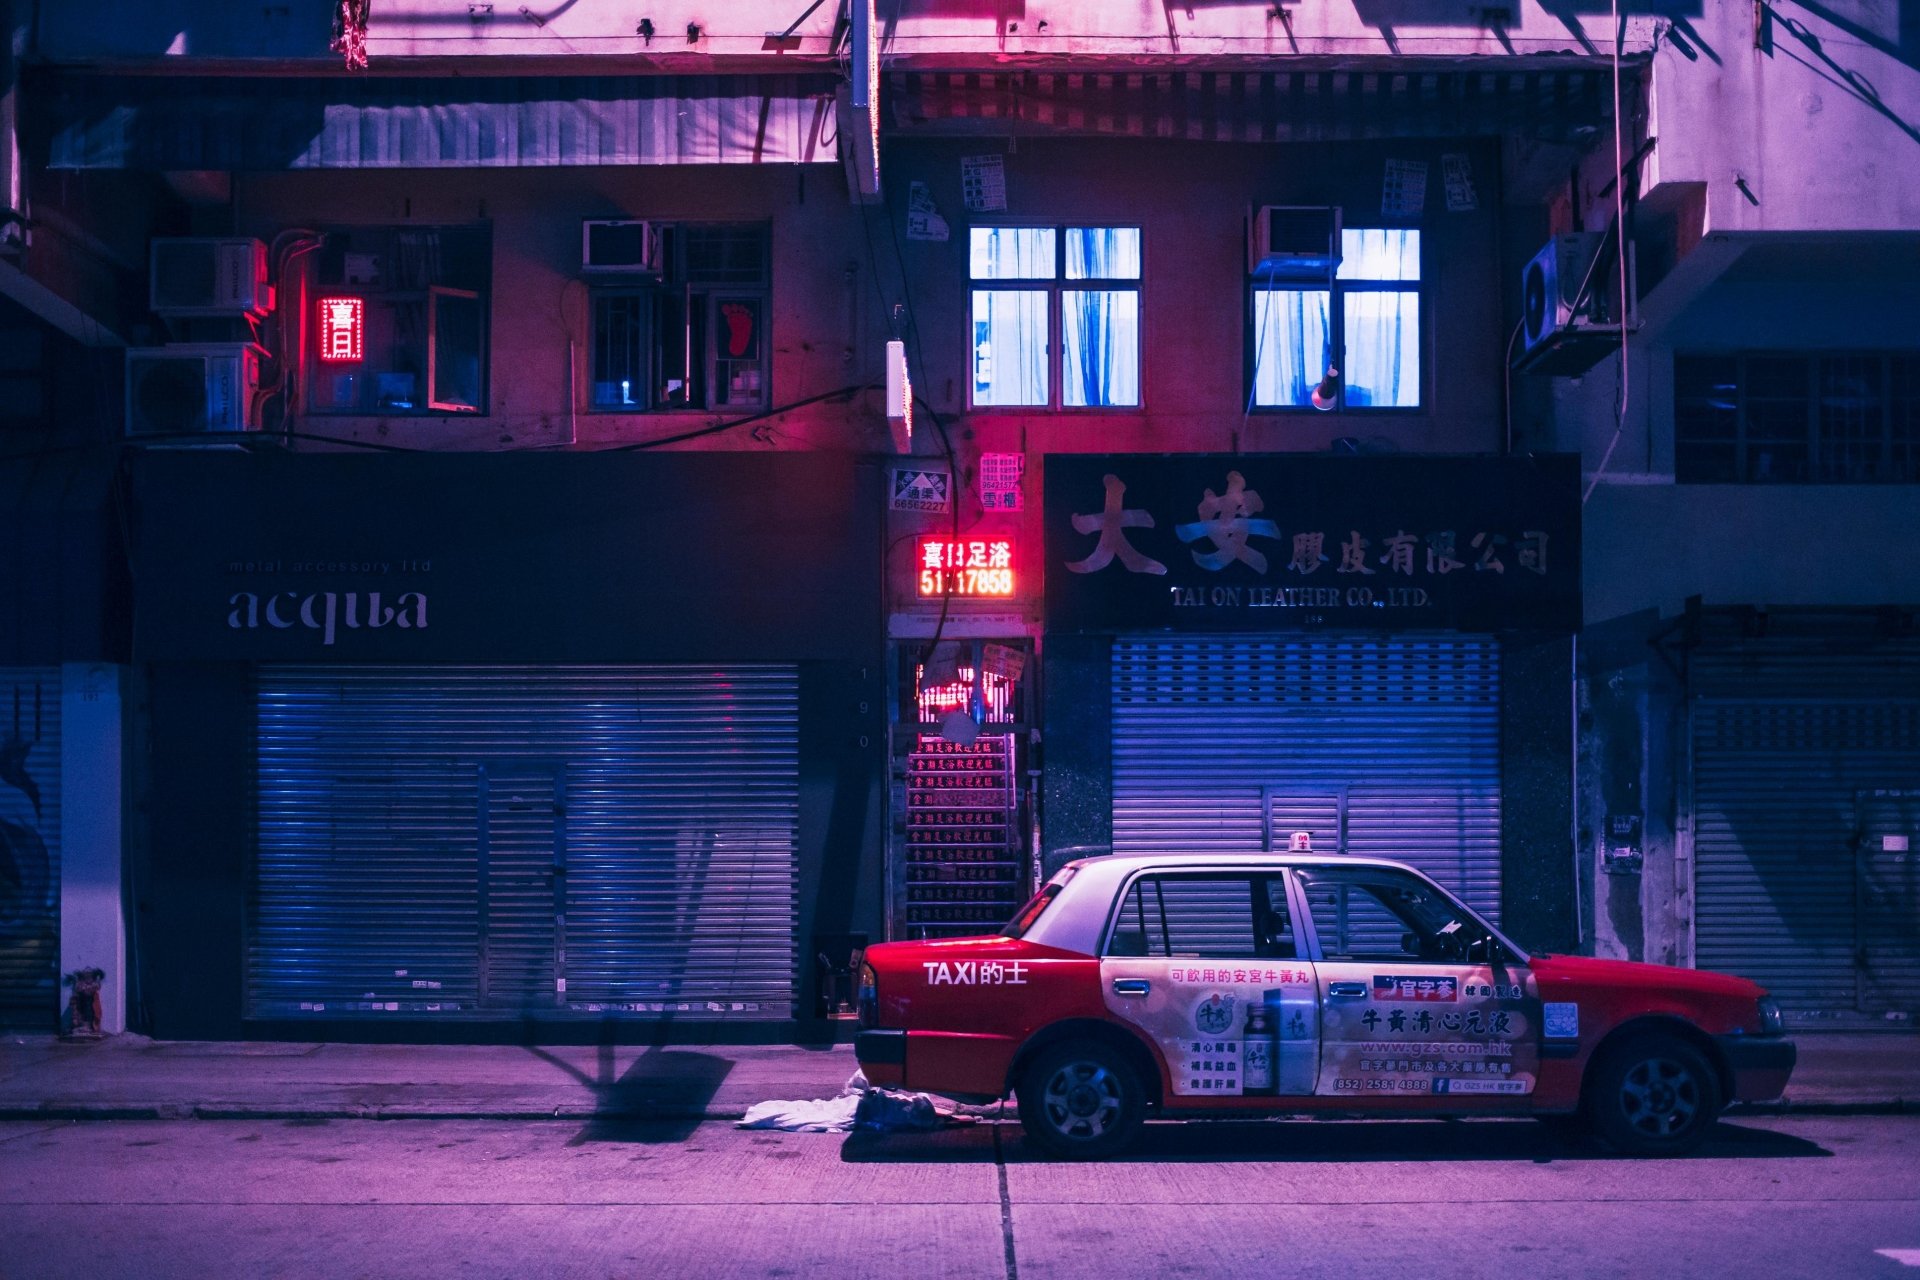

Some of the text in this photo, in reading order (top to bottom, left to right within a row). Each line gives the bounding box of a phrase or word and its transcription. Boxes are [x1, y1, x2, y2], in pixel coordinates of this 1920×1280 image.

[328, 302, 356, 356] 喜日
[907, 486, 934, 500] 通渠
[229, 560, 431, 574] metal accessory ltd
[921, 569, 1012, 594] 5117858
[1170, 586, 1206, 608] TAI
[1210, 587, 1240, 607] ON
[1248, 587, 1340, 607] LEATHER
[1388, 587, 1432, 607] LTD.
[227, 592, 429, 645] acqua
[923, 961, 1029, 985] TAXI 的士
[1172, 968, 1310, 984] 可飲用的安宮牛黃丸
[1361, 1008, 1512, 1034] 牛黃清心元液
[1192, 1042, 1236, 1053] 清心解毒
[1360, 1039, 1513, 1058] www.gzs.com.hk
[1191, 1061, 1236, 1072] 補氣益血
[1334, 1079, 1428, 1090] (852) 2581 4888
